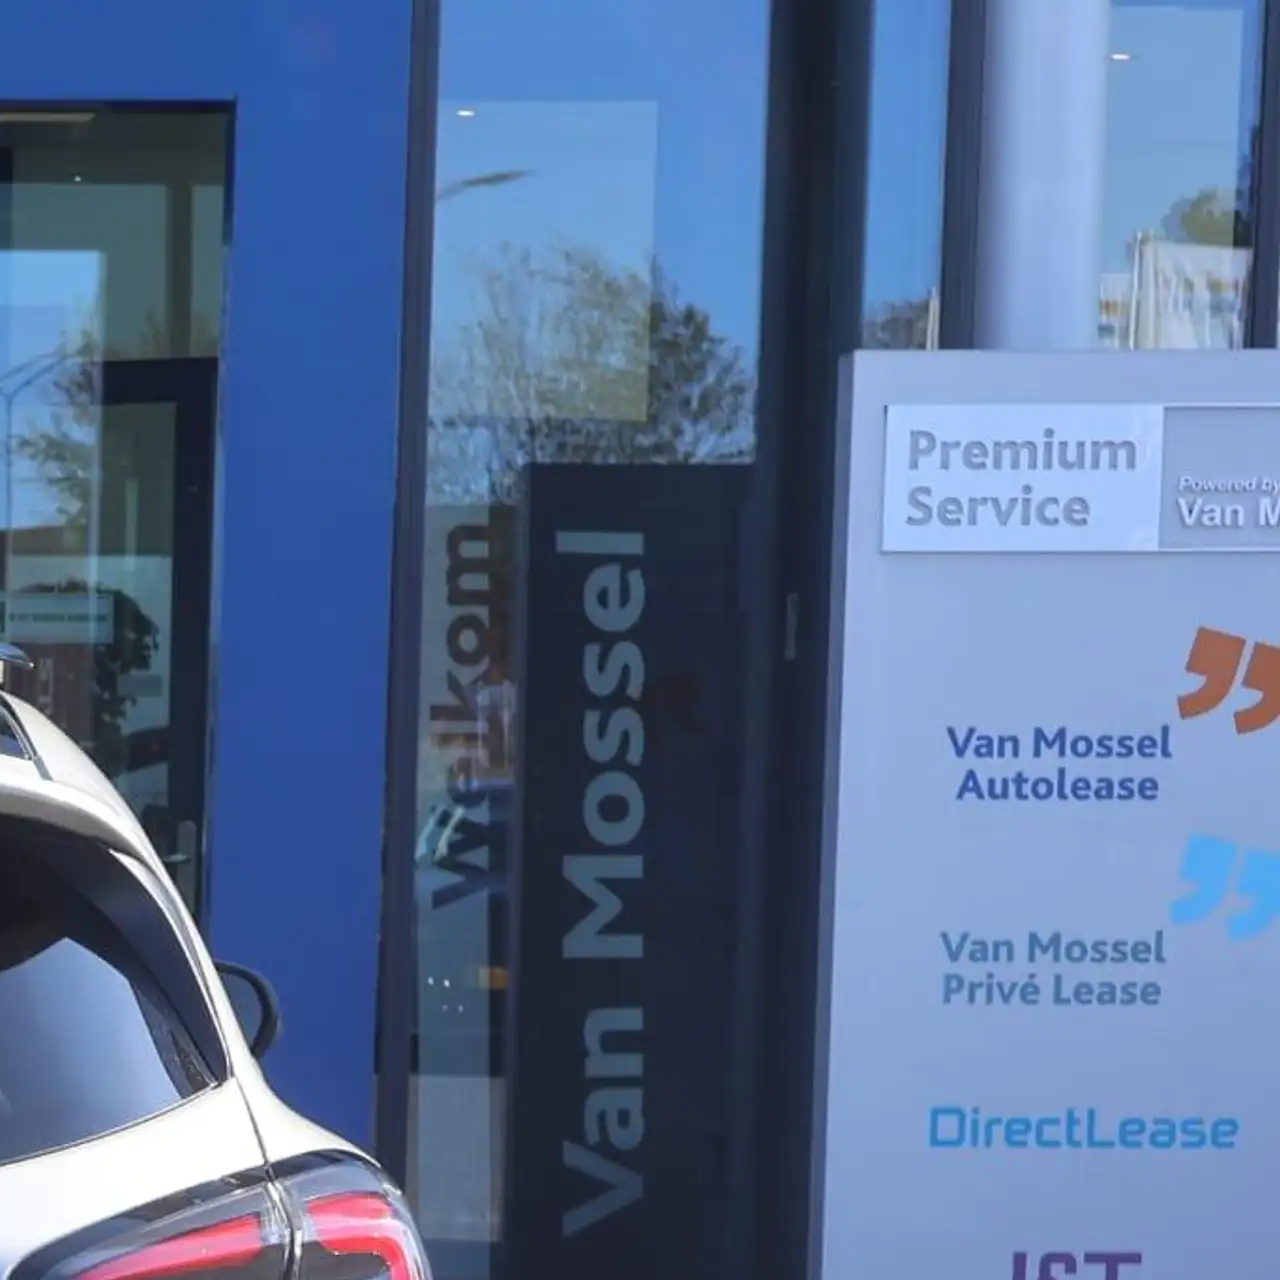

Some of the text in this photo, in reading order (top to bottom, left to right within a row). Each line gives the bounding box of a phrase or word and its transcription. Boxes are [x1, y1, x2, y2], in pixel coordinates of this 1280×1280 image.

[908, 428, 1137, 471] Premium
[1178, 476, 1258, 492] Powered
[905, 484, 1091, 527] Service
[1178, 498, 1245, 526] Van
[947, 725, 1173, 759] Van Mossel
[956, 767, 1160, 802] Autolease
[556, 531, 646, 1238] Van Mossel
[941, 930, 1167, 964] Van Mossel
[942, 972, 1162, 1006] Privé Lease
[929, 1106, 1240, 1150] DirectLease
